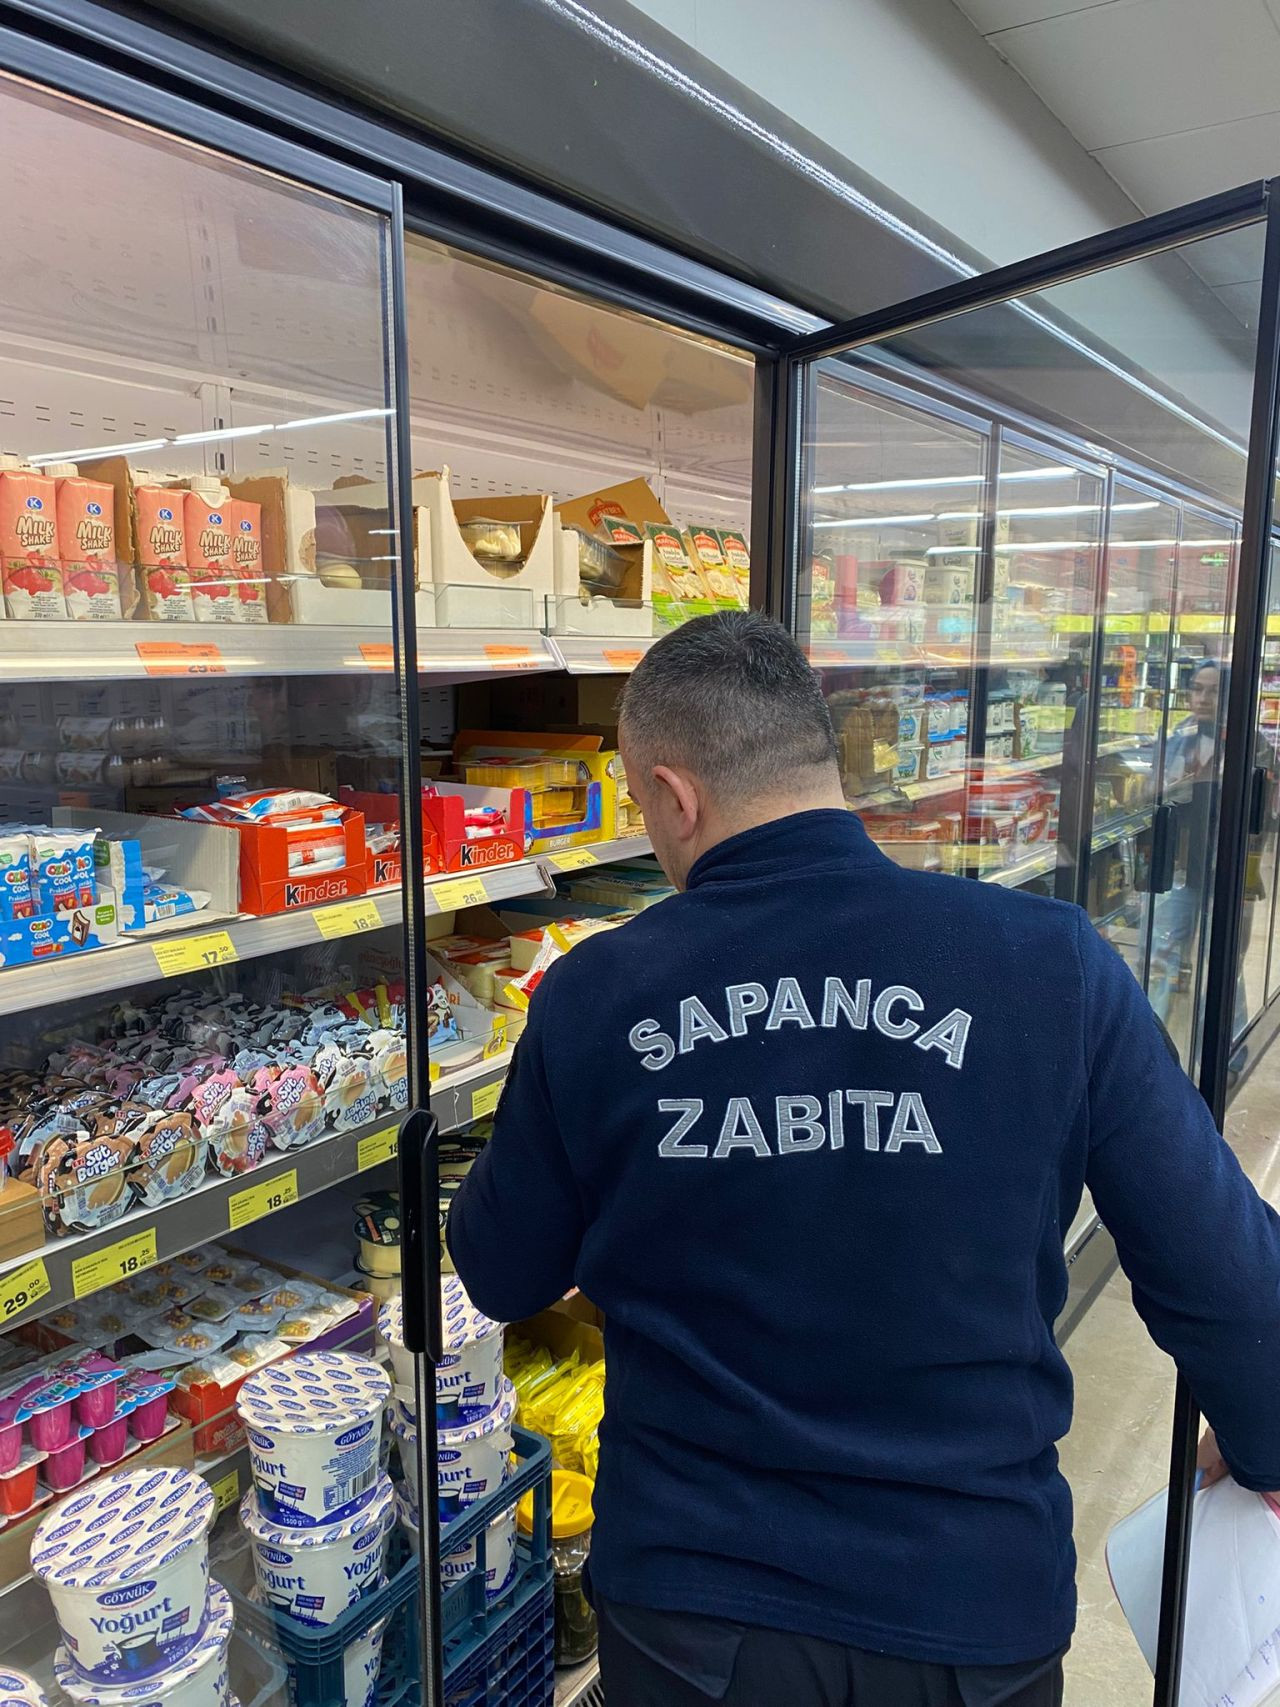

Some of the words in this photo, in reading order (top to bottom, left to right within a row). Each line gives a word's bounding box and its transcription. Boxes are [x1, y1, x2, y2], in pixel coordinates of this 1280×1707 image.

[53, 875, 72, 885] COOL
[463, 893, 477, 905] 26
[352, 917, 369, 931] 18
[628, 976, 973, 1071] SAPANCA
[657, 1089, 943, 1158] ZABITA
[150, 1129, 173, 1153] Süt
[86, 1144, 112, 1166] Süt
[76, 1151, 121, 1183] Burger
[267, 1194, 282, 1210] 18
[119, 1256, 139, 1275] 18
[3, 1291, 28, 1315] 29
[104, 1584, 150, 1605] GÖYNÜK
[90, 1597, 173, 1634] Yoğurt
